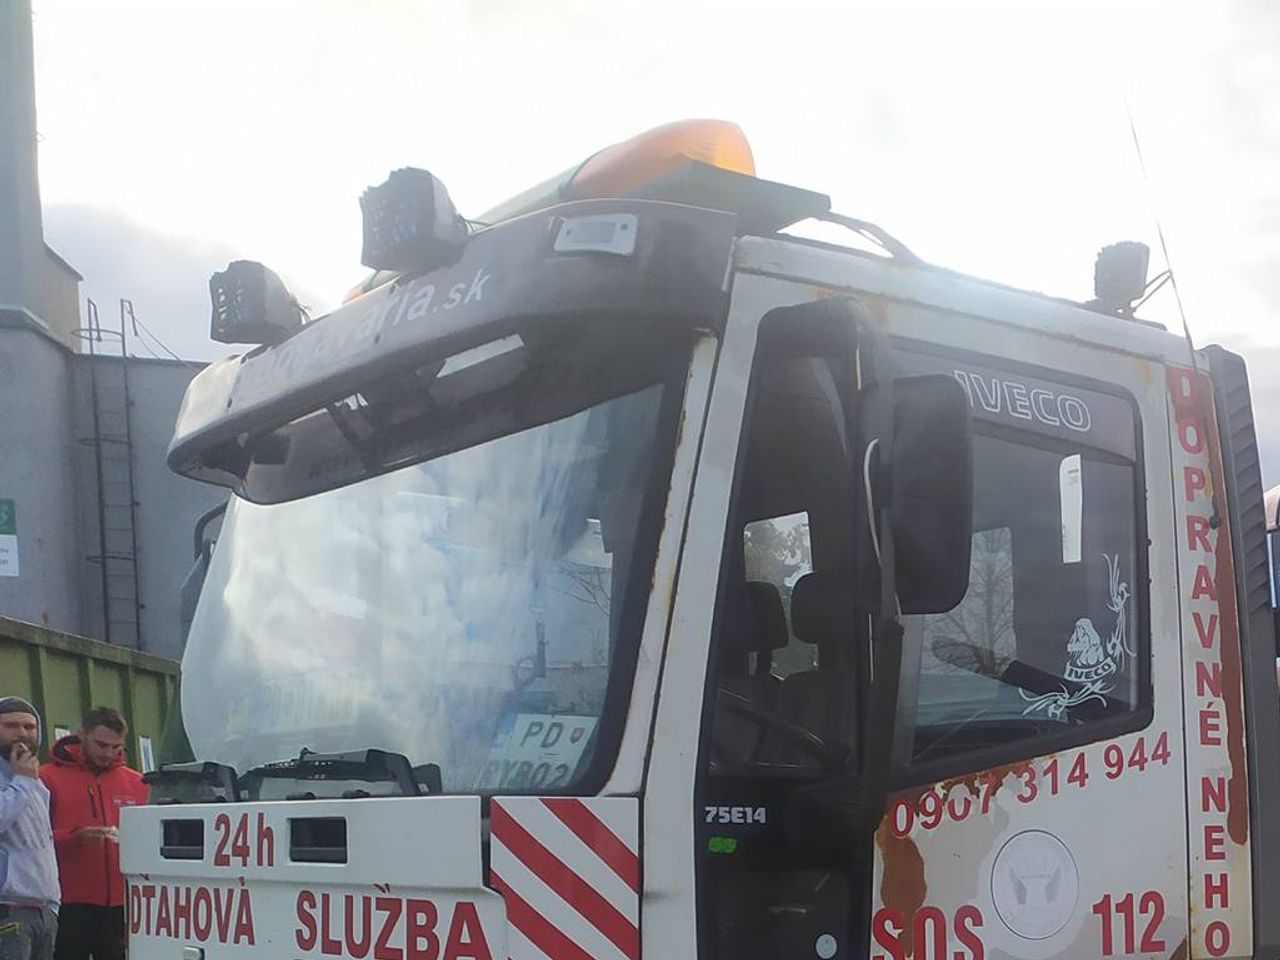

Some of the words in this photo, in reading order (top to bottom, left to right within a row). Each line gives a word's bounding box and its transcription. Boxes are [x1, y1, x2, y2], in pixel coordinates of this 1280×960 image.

[1170, 374, 1223, 746] DOPRAVNÉ
[1067, 662, 1112, 680] IVECO
[519, 721, 564, 749] PD
[1016, 752, 1089, 804] 314
[1103, 731, 1171, 780] 944
[704, 806, 767, 824] 75E14
[1093, 890, 1166, 957] 112
